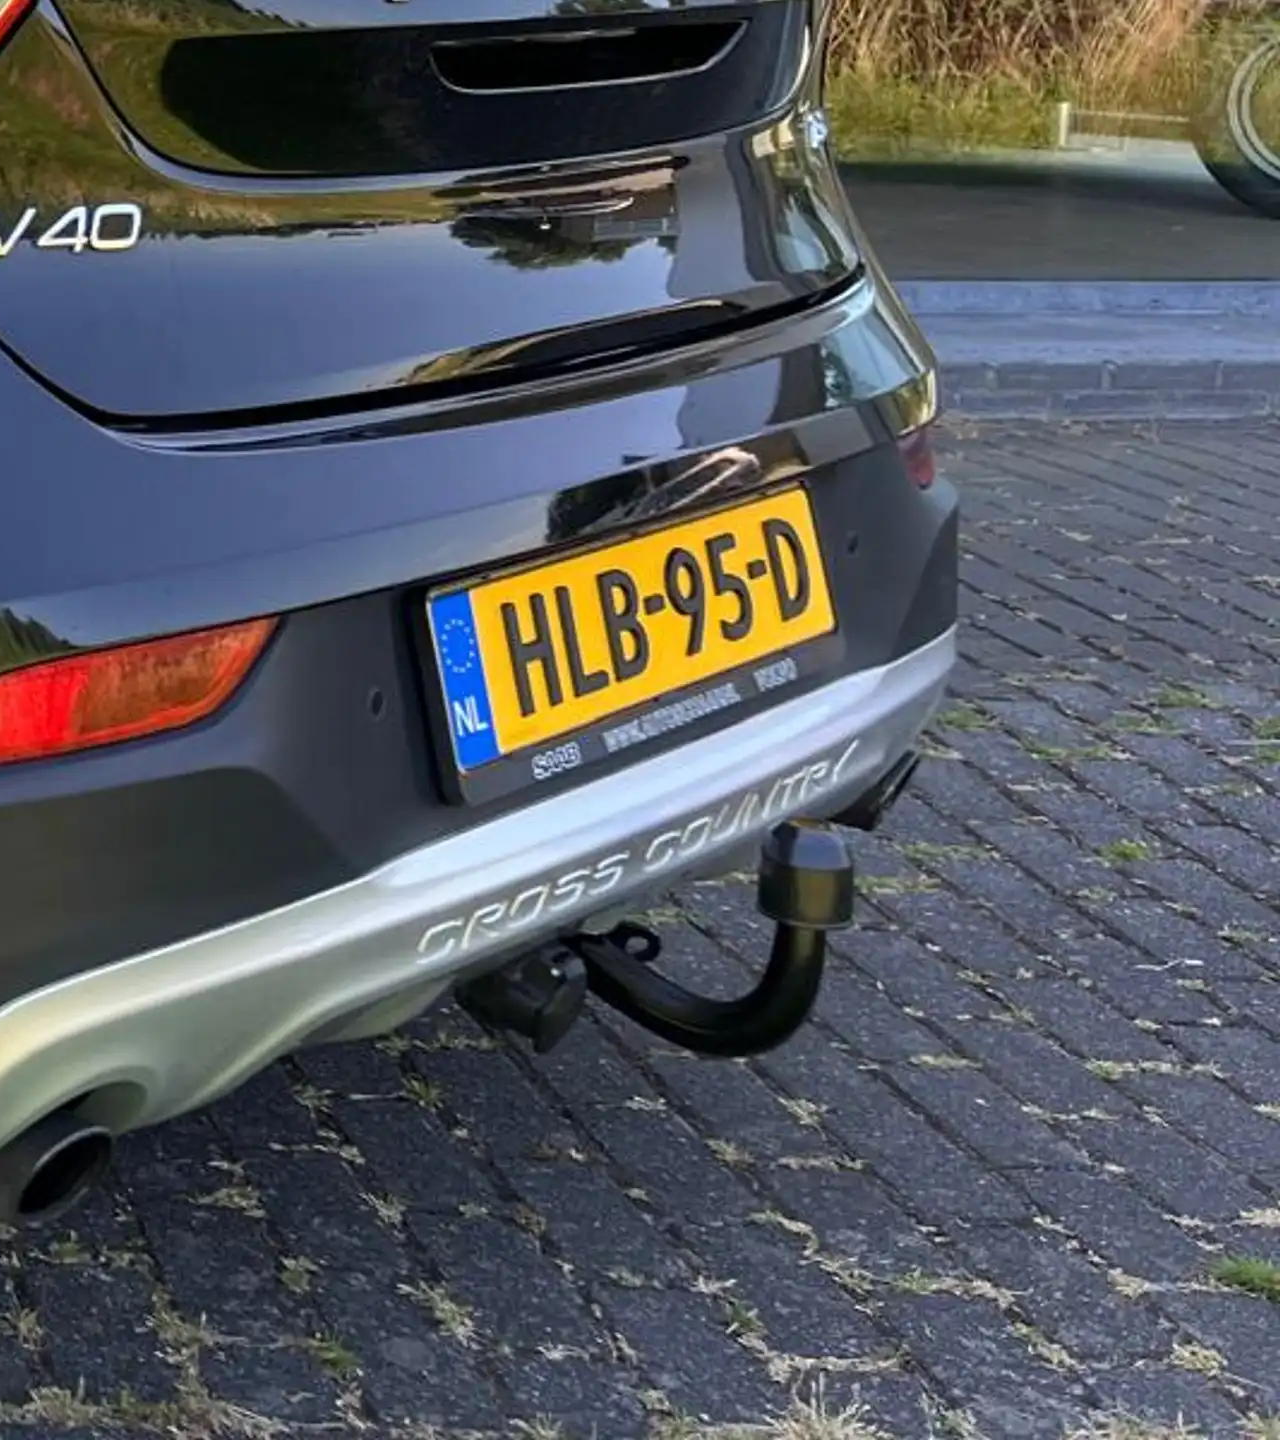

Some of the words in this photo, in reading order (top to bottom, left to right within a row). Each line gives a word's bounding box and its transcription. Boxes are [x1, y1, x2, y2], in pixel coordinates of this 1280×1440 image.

[501, 517, 812, 718] HLB-95-D
[453, 697, 490, 738] NL
[415, 850, 631, 966] CROSS
